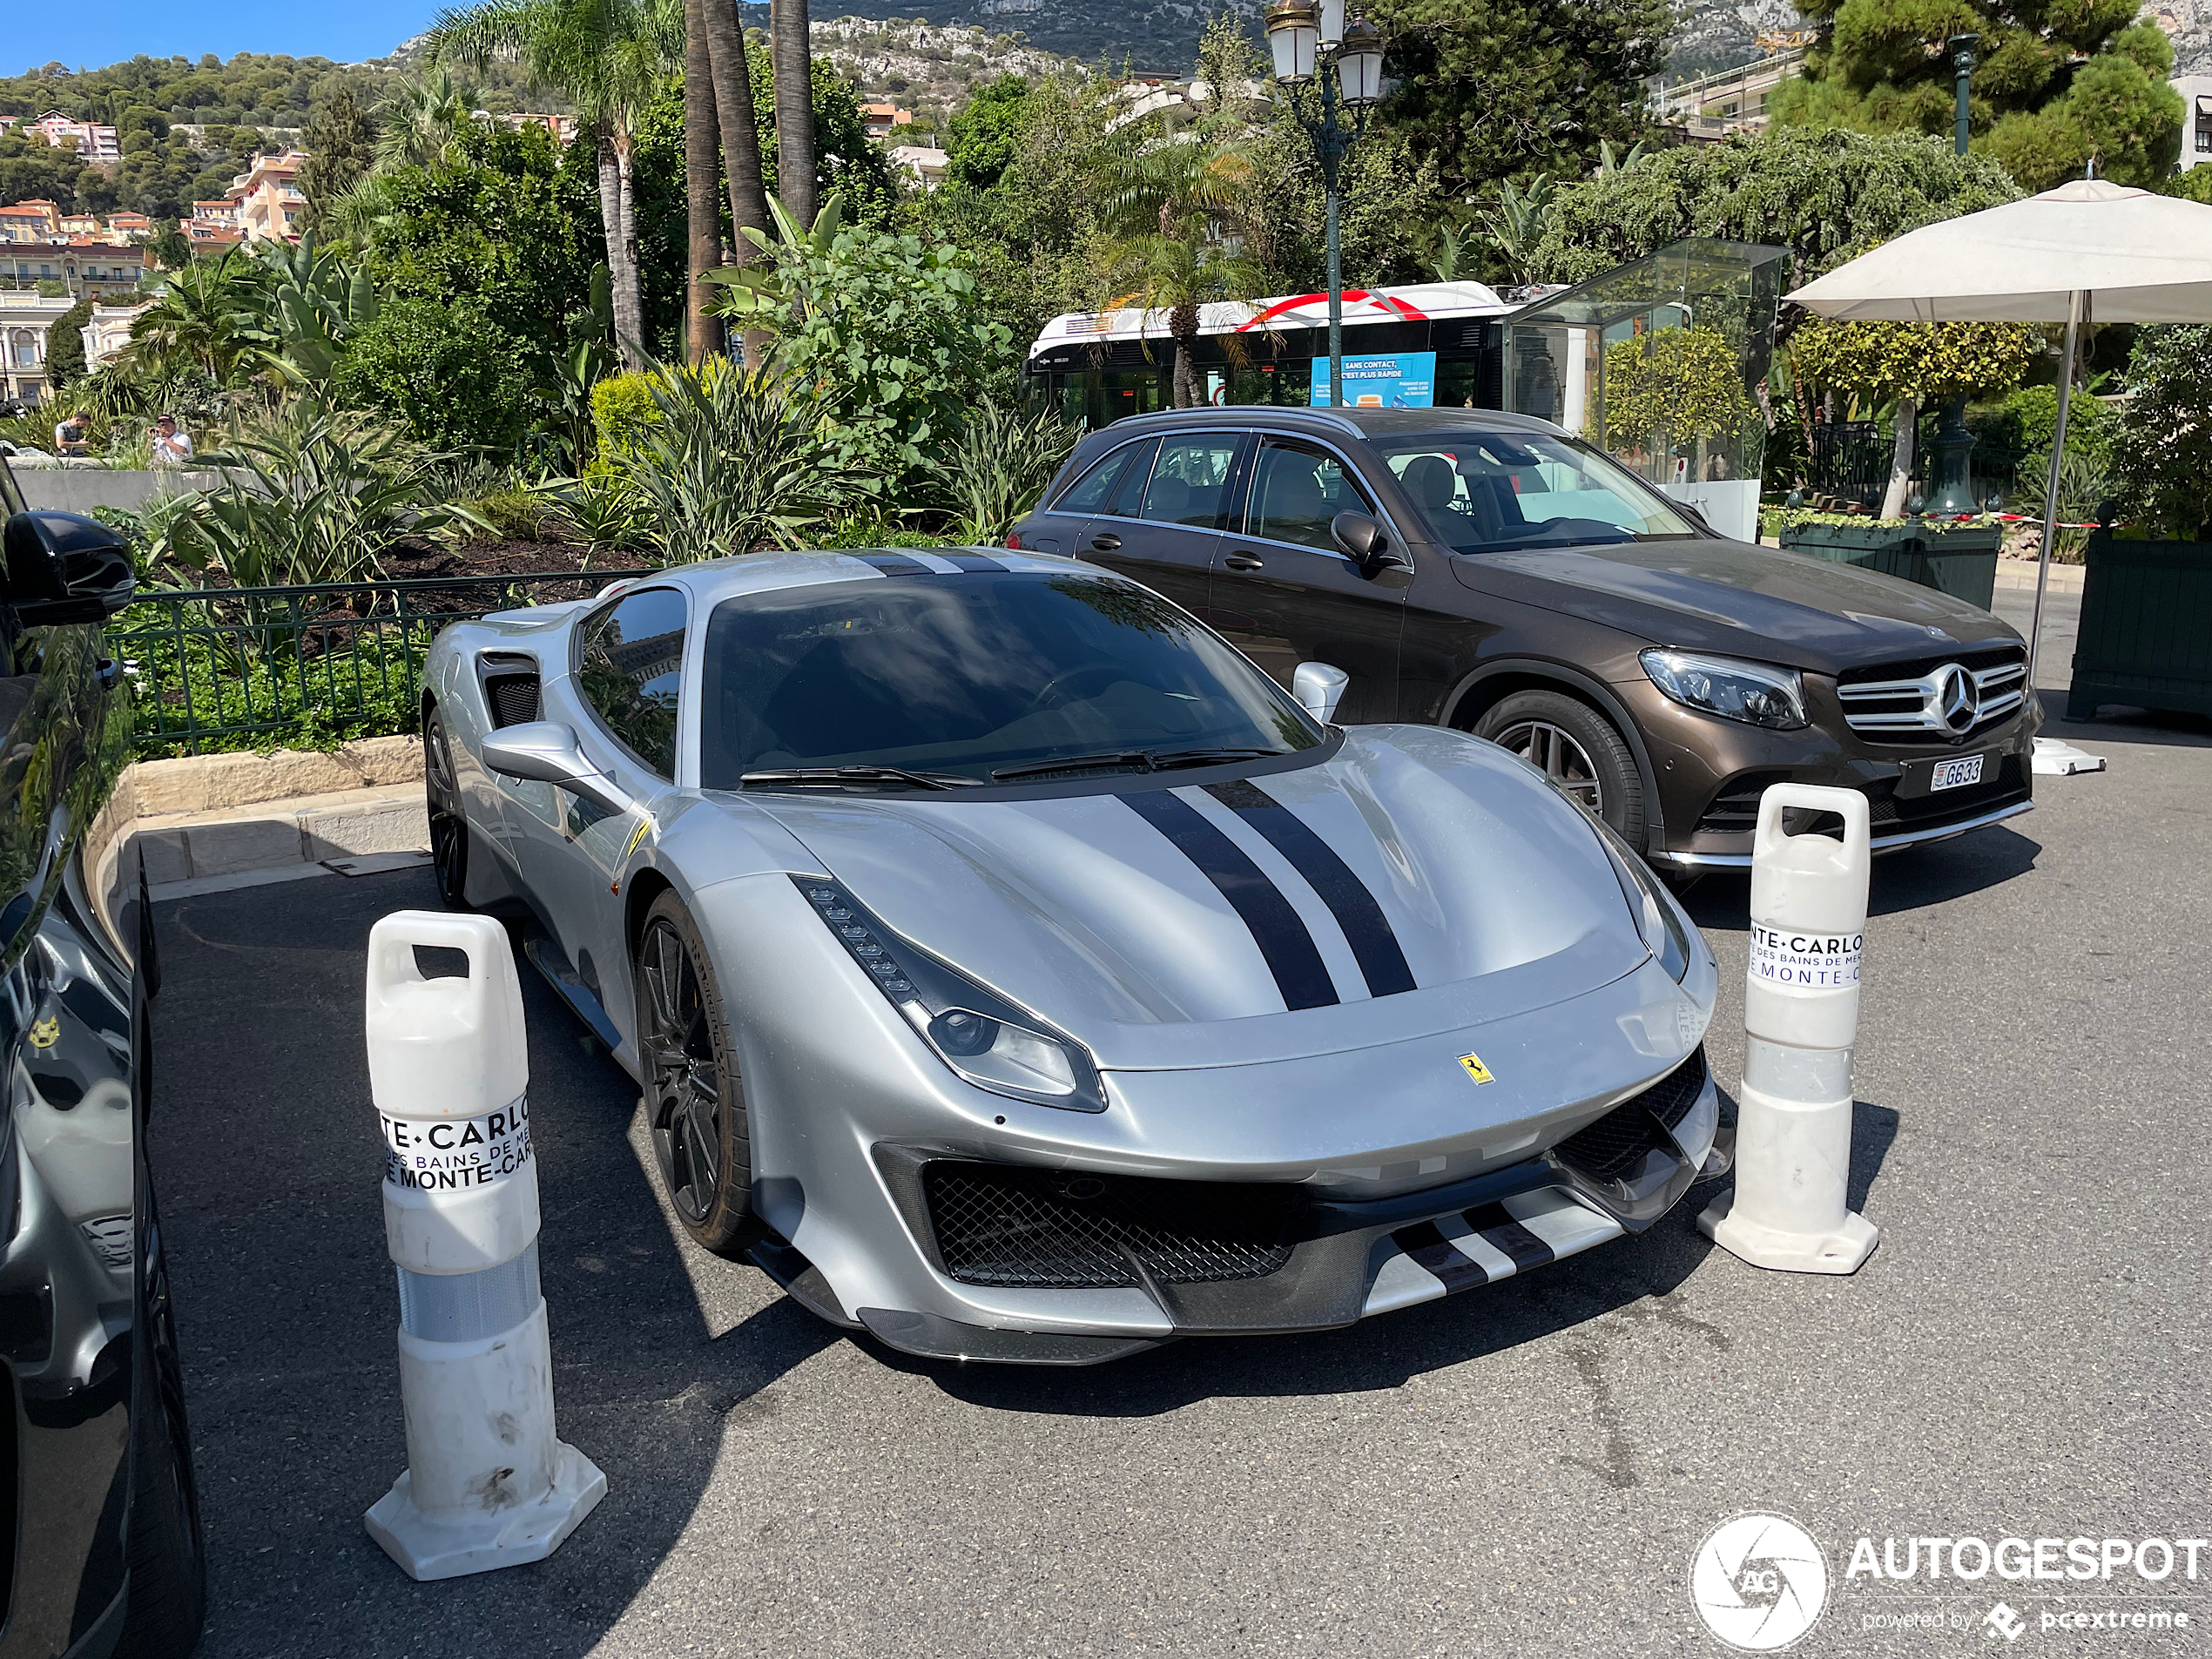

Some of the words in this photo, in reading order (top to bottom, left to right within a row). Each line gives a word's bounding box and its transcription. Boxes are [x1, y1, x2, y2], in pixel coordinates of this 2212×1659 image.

[1946, 760, 1980, 786] G633
[1757, 947, 1775, 960] DES
[1780, 954, 1820, 966] BAINS
[385, 1147, 408, 1167] DES
[416, 1151, 480, 1169] BAINS
[489, 1140, 511, 1159] DE
